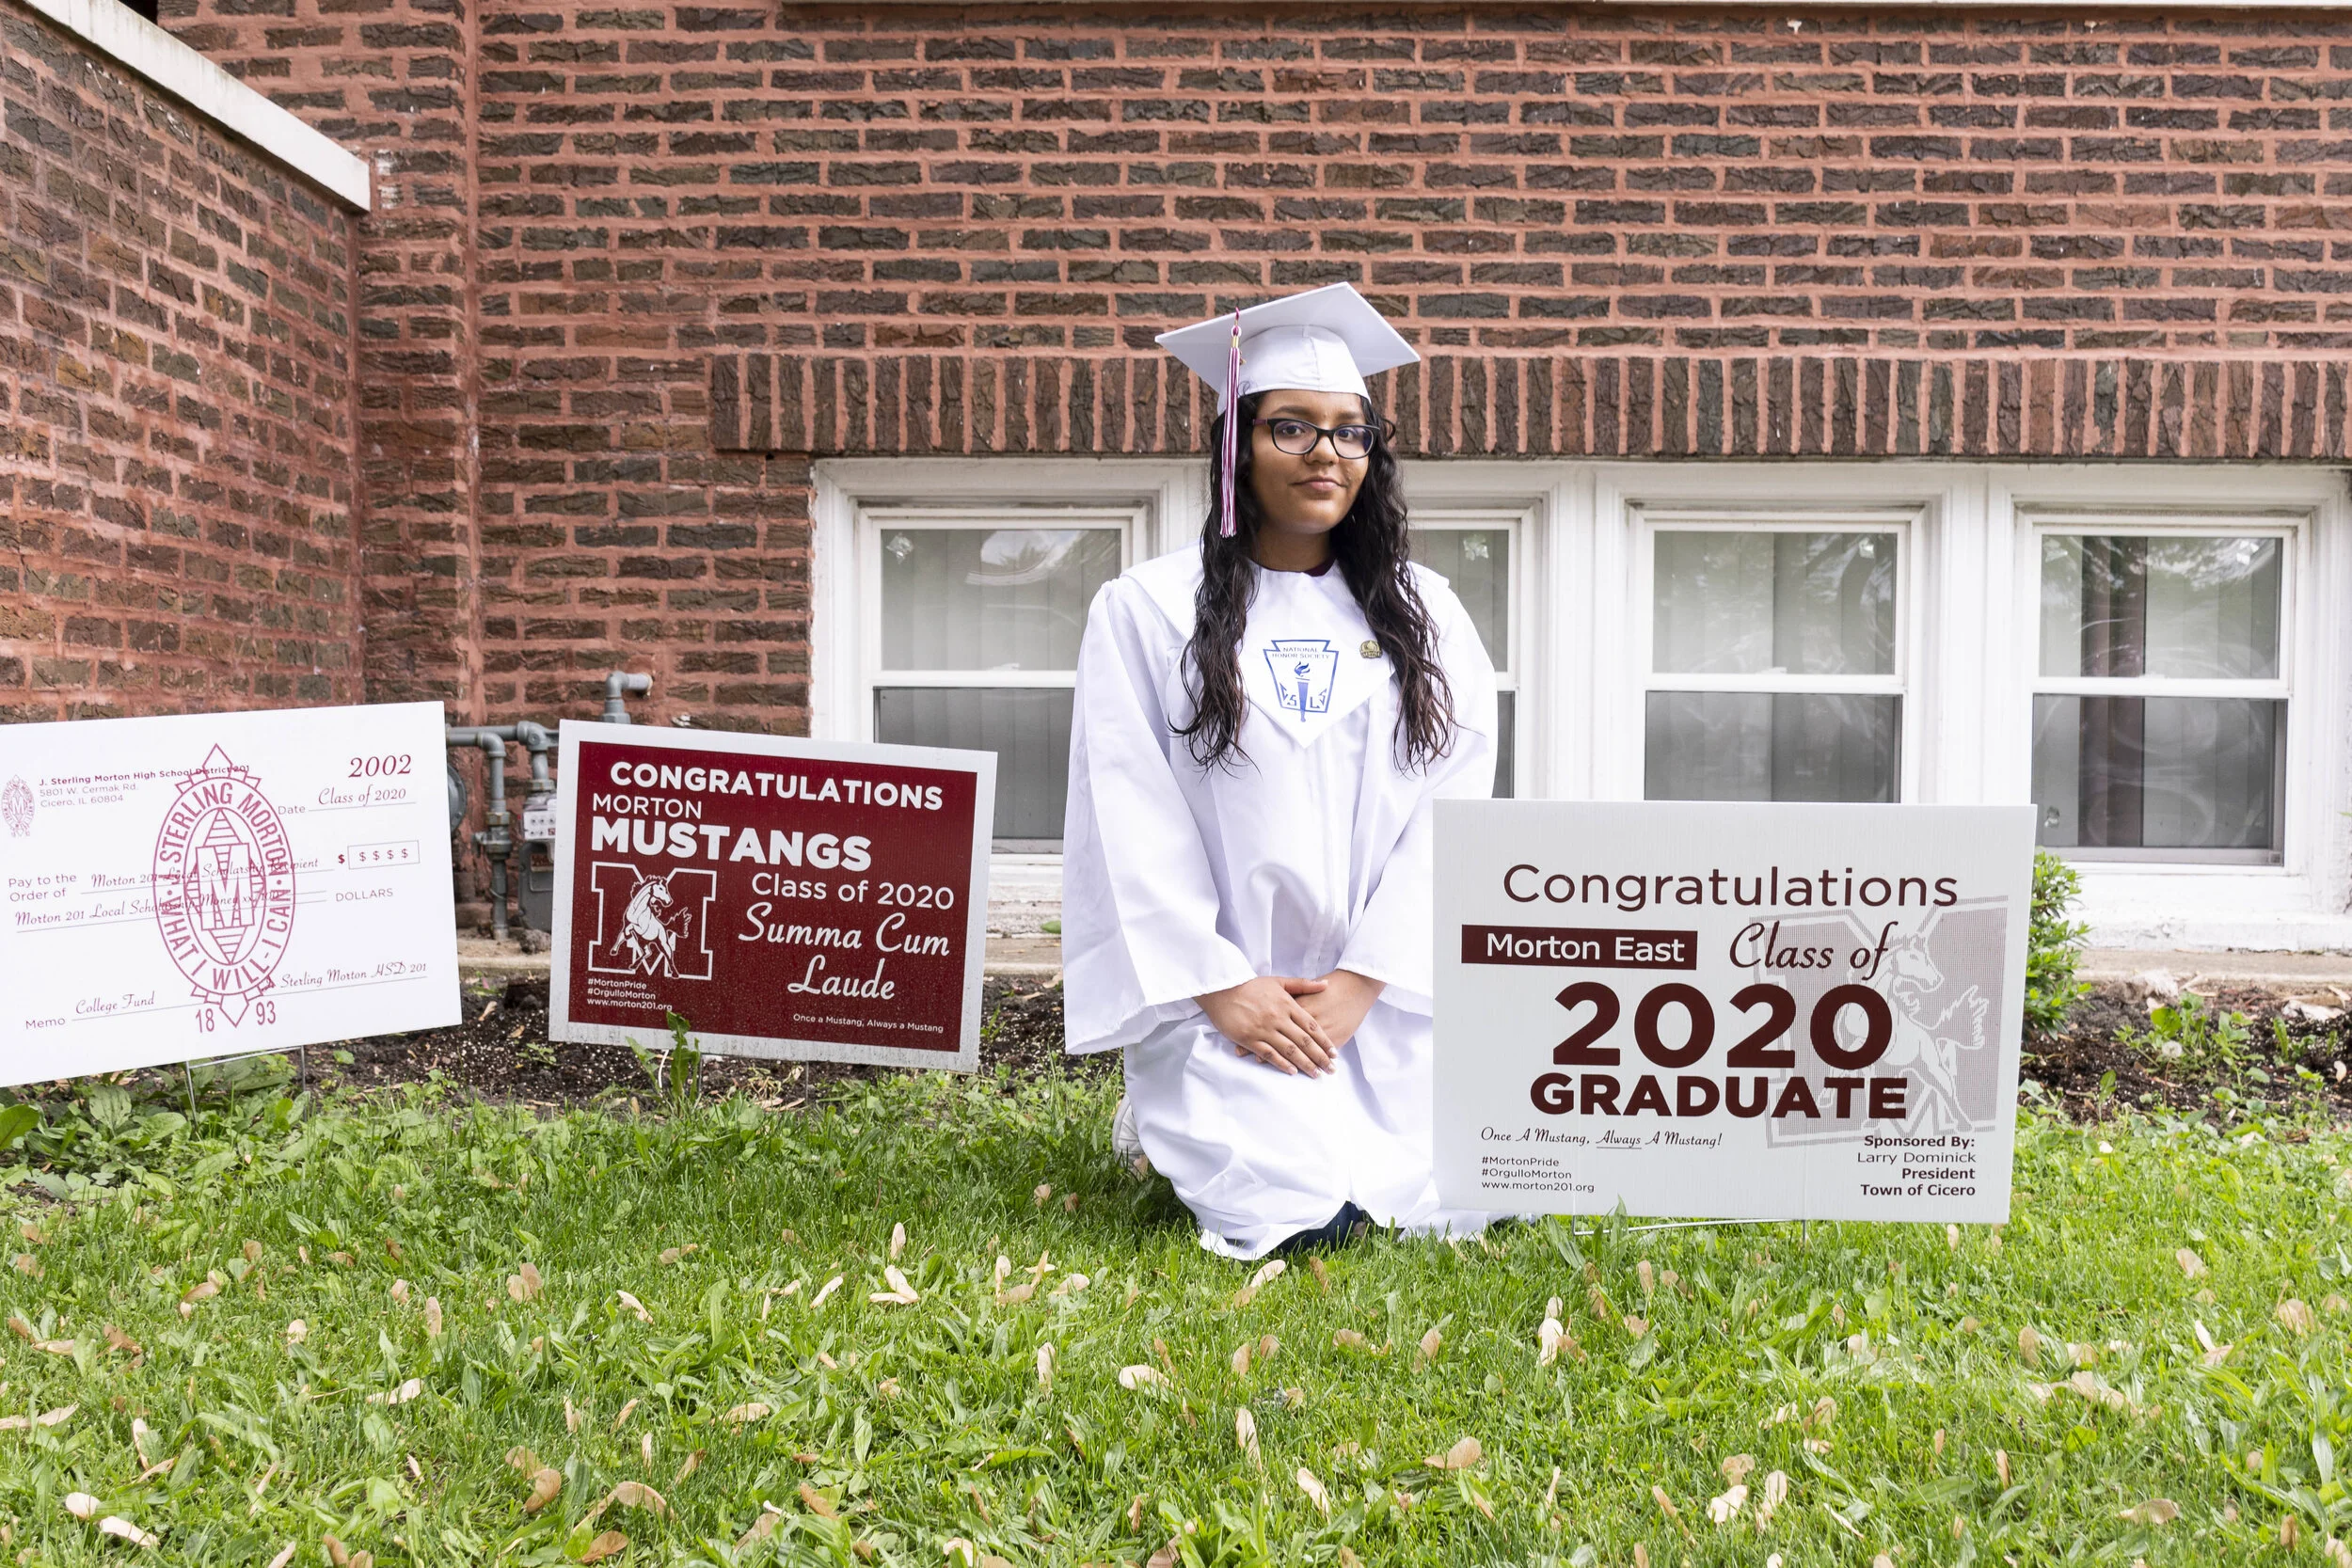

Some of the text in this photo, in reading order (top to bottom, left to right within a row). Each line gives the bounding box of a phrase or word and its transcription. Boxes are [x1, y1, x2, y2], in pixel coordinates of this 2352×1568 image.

[348, 754, 411, 778] 2002
[51, 775, 91, 786] Sterling
[94, 773, 130, 783] Morton
[134, 771, 156, 781] High
[160, 768, 192, 777] School
[611, 761, 943, 811] CONGRATULATIONS
[40, 787, 63, 798] 5801
[82, 784, 119, 795] Cermak
[78, 796, 87, 805] IL
[90, 794, 123, 804] 60804
[318, 784, 406, 807] Class of 2020
[278, 805, 306, 815] Date
[593, 793, 702, 818] MORTON
[159, 782, 233, 863] STERLING
[591, 816, 871, 872] MUSTANGS
[338, 854, 346, 864] $
[8, 874, 77, 890] Pay to the
[91, 873, 135, 888] Morton
[140, 875, 158, 884] 201
[1503, 863, 1959, 912] Congratulations
[9, 888, 66, 902] Order of
[336, 888, 393, 901] DOLLARS
[752, 873, 954, 911] Class of 2020
[15, 911, 61, 926] Morton
[66, 911, 85, 921] 201
[89, 901, 124, 918] Local
[738, 901, 950, 957] Summa Cum
[1486, 932, 1685, 963] Morton East
[1729, 920, 1899, 981] Class of
[280, 972, 323, 988] Sterling
[327, 969, 367, 982] Morton
[410, 962, 427, 973] 201
[587, 978, 647, 990] #MortonPride
[787, 954, 895, 1000] Laude
[75, 990, 155, 1014] College Fund
[587, 988, 657, 1000] #OrgulloMorton
[587, 997, 673, 1012] www.morton201.org
[25, 1018, 66, 1029] Memo
[196, 1001, 276, 1033] 18 93
[793, 1013, 816, 1023] Once
[826, 1016, 866, 1027] Mustang,
[866, 1019, 898, 1030] Always
[907, 1022, 944, 1034] Mustang
[1552, 981, 1893, 1070] 2020
[1530, 1071, 1908, 1119] GRADUATE
[1481, 1126, 1724, 1149] Once A Mustang, Always A Mustang!
[1864, 1134, 1976, 1149] Sponsored By:
[1481, 1156, 1560, 1166] #MortonPride
[1857, 1151, 1976, 1164] Larry Dominick
[1481, 1168, 1571, 1180] #OrgulloMorton
[1902, 1168, 1976, 1180] President
[1481, 1181, 1595, 1193] www.morton201.org
[1861, 1183, 1976, 1196] Town of Cicero
